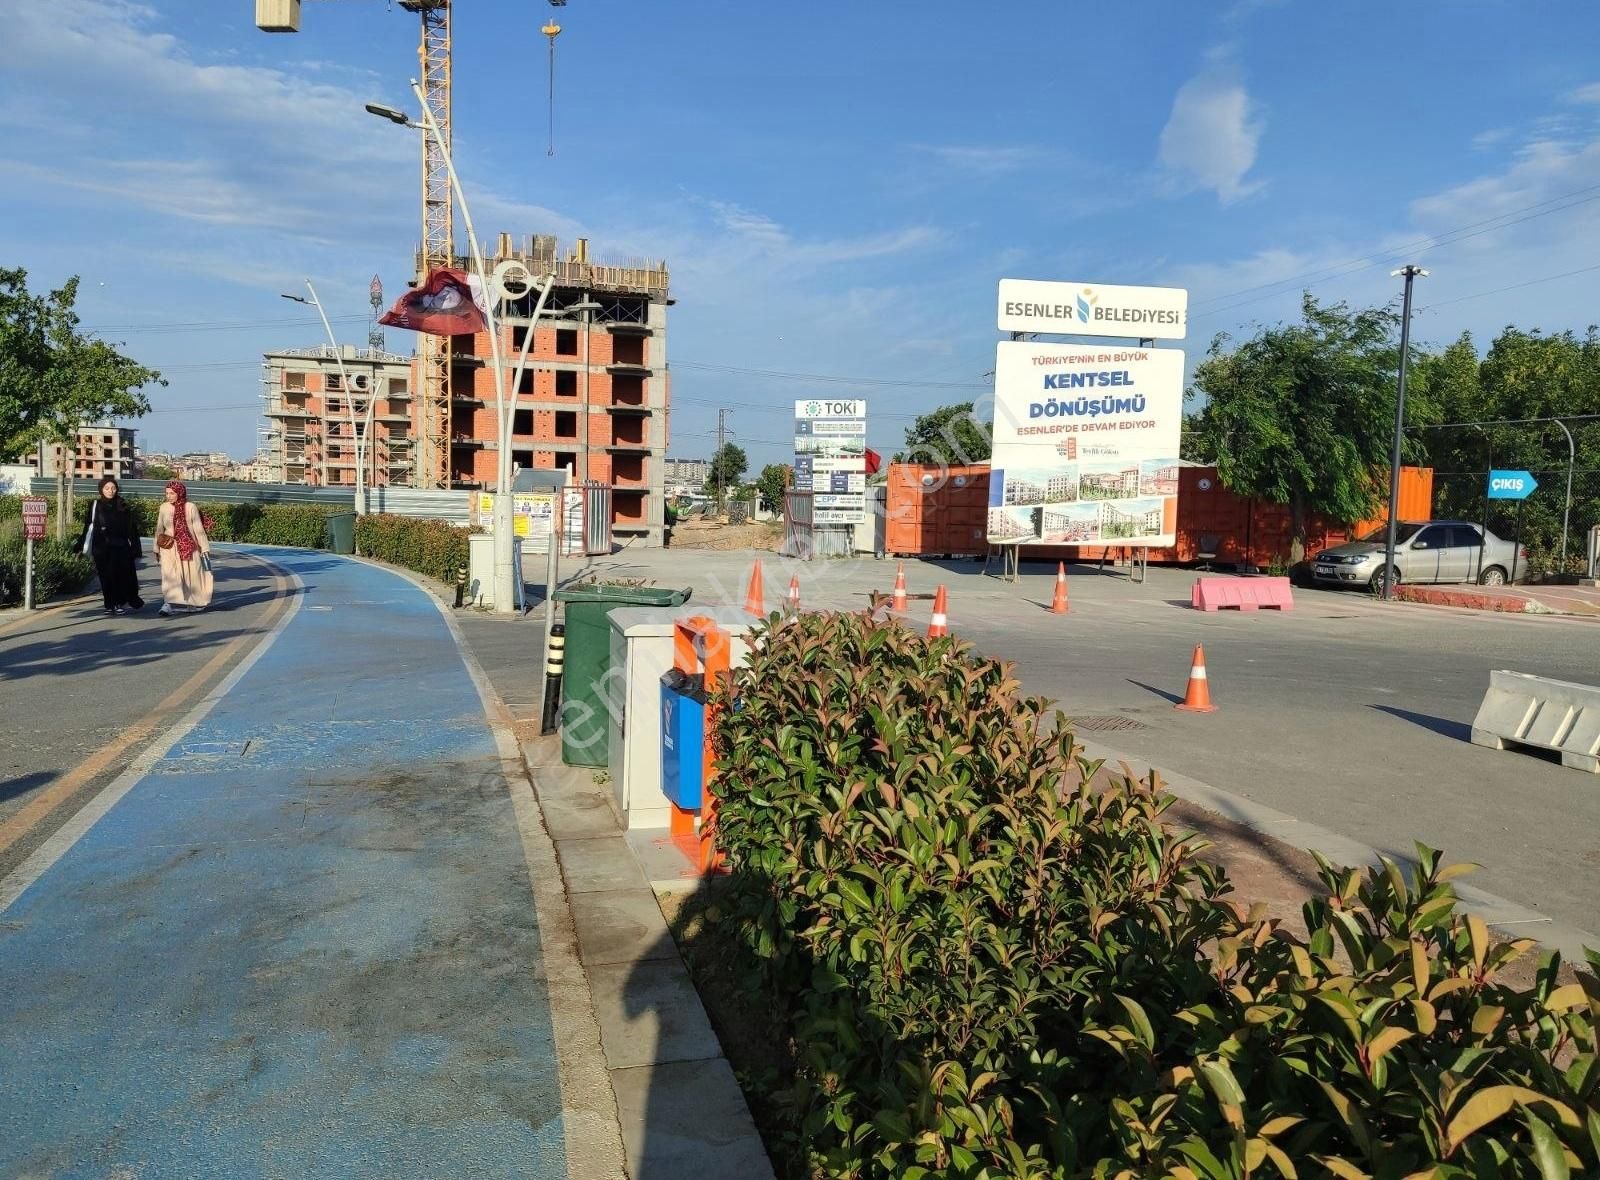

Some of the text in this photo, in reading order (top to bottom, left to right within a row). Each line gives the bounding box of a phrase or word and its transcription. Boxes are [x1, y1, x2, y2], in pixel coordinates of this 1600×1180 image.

[1005, 301, 1073, 319] ESENLER
[1098, 354, 1111, 363] EN
[1113, 351, 1149, 362] BÜYÜK
[1044, 371, 1135, 389] KENTSEL
[1029, 394, 1146, 418] DÖNÜŞÜMÜ
[1017, 425, 1079, 436] ESENLER'DE
[1081, 422, 1117, 432] DEVAM
[1491, 478, 1524, 492] ÇIKIŞ
